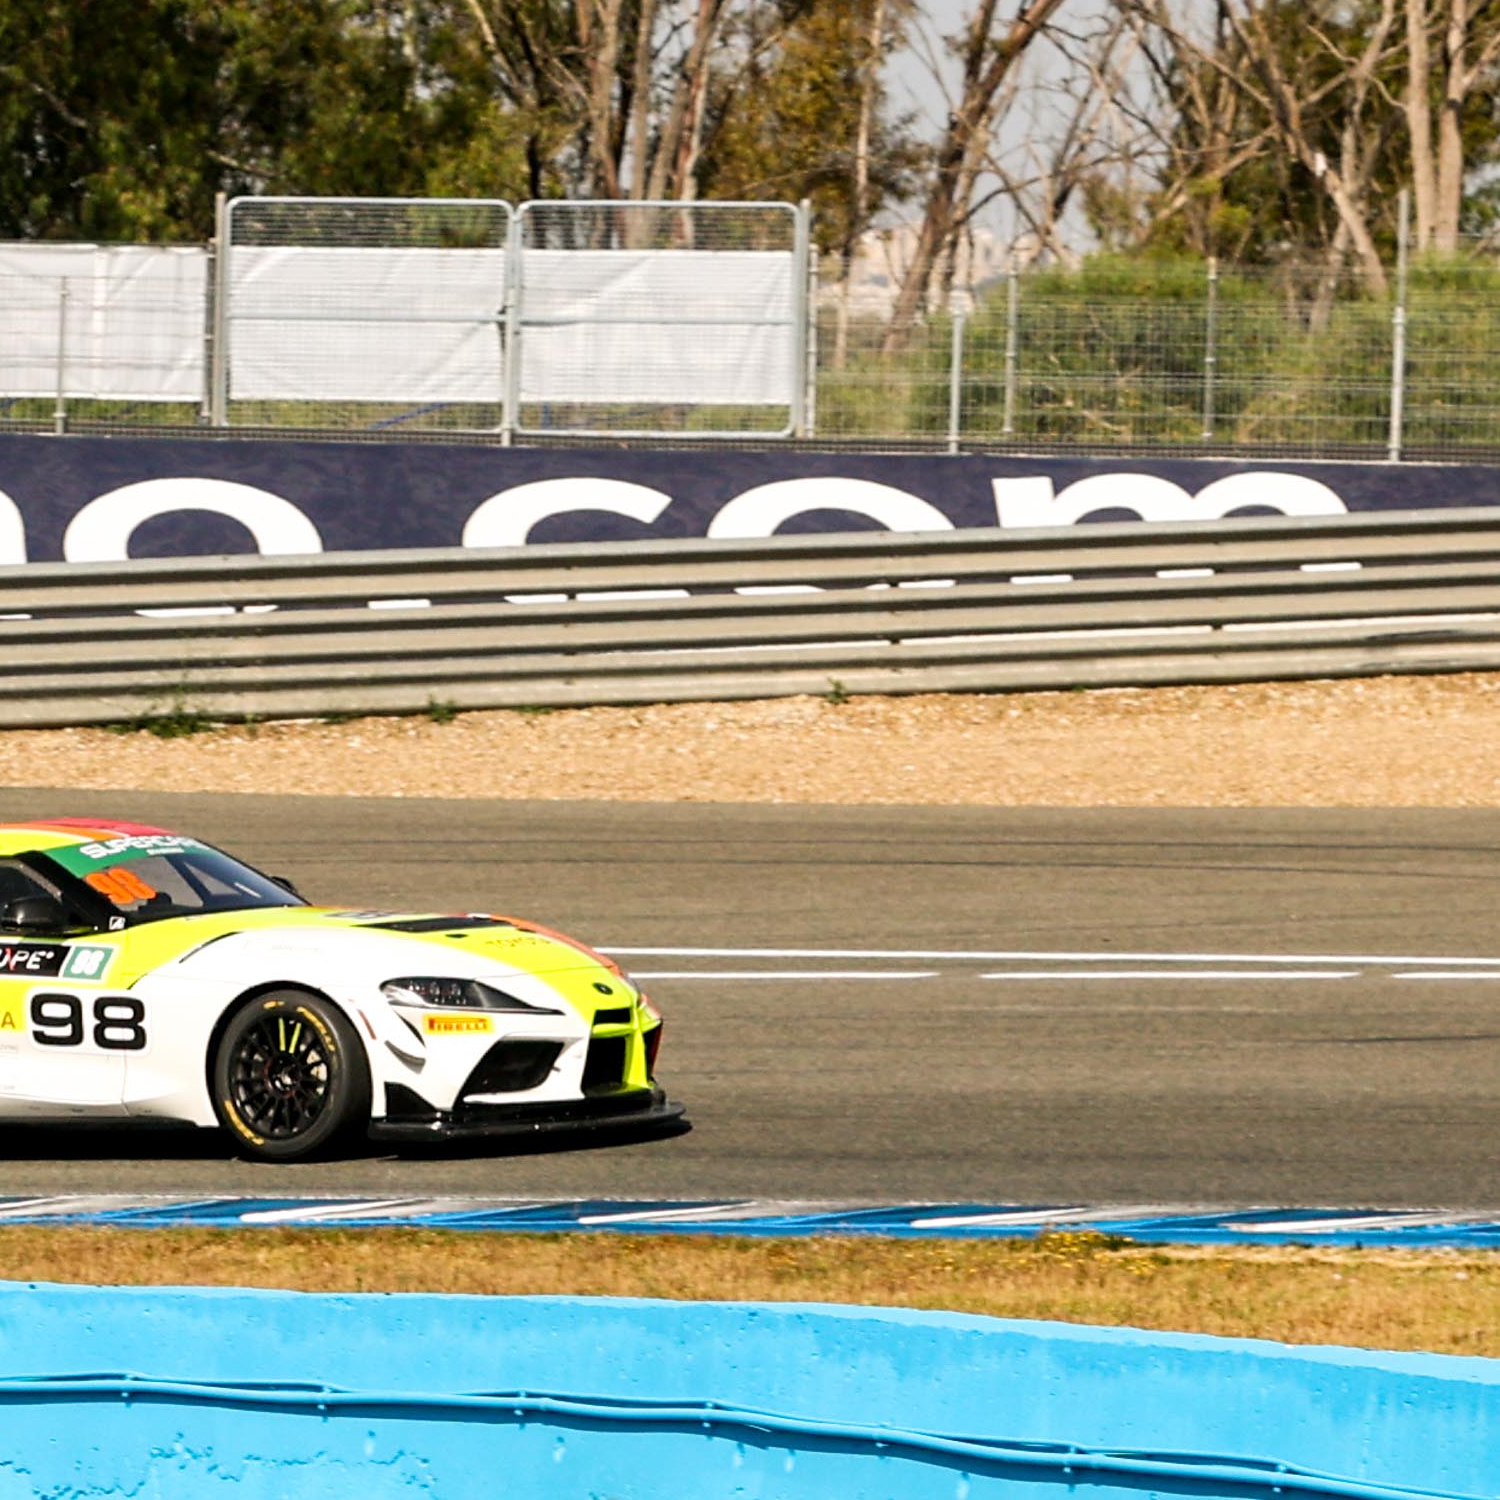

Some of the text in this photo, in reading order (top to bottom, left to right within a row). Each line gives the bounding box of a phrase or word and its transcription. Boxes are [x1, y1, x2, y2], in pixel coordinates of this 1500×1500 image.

[84, 865, 157, 905] 98
[29, 992, 148, 1051] 98
[428, 1017, 488, 1031] PIRELLI
